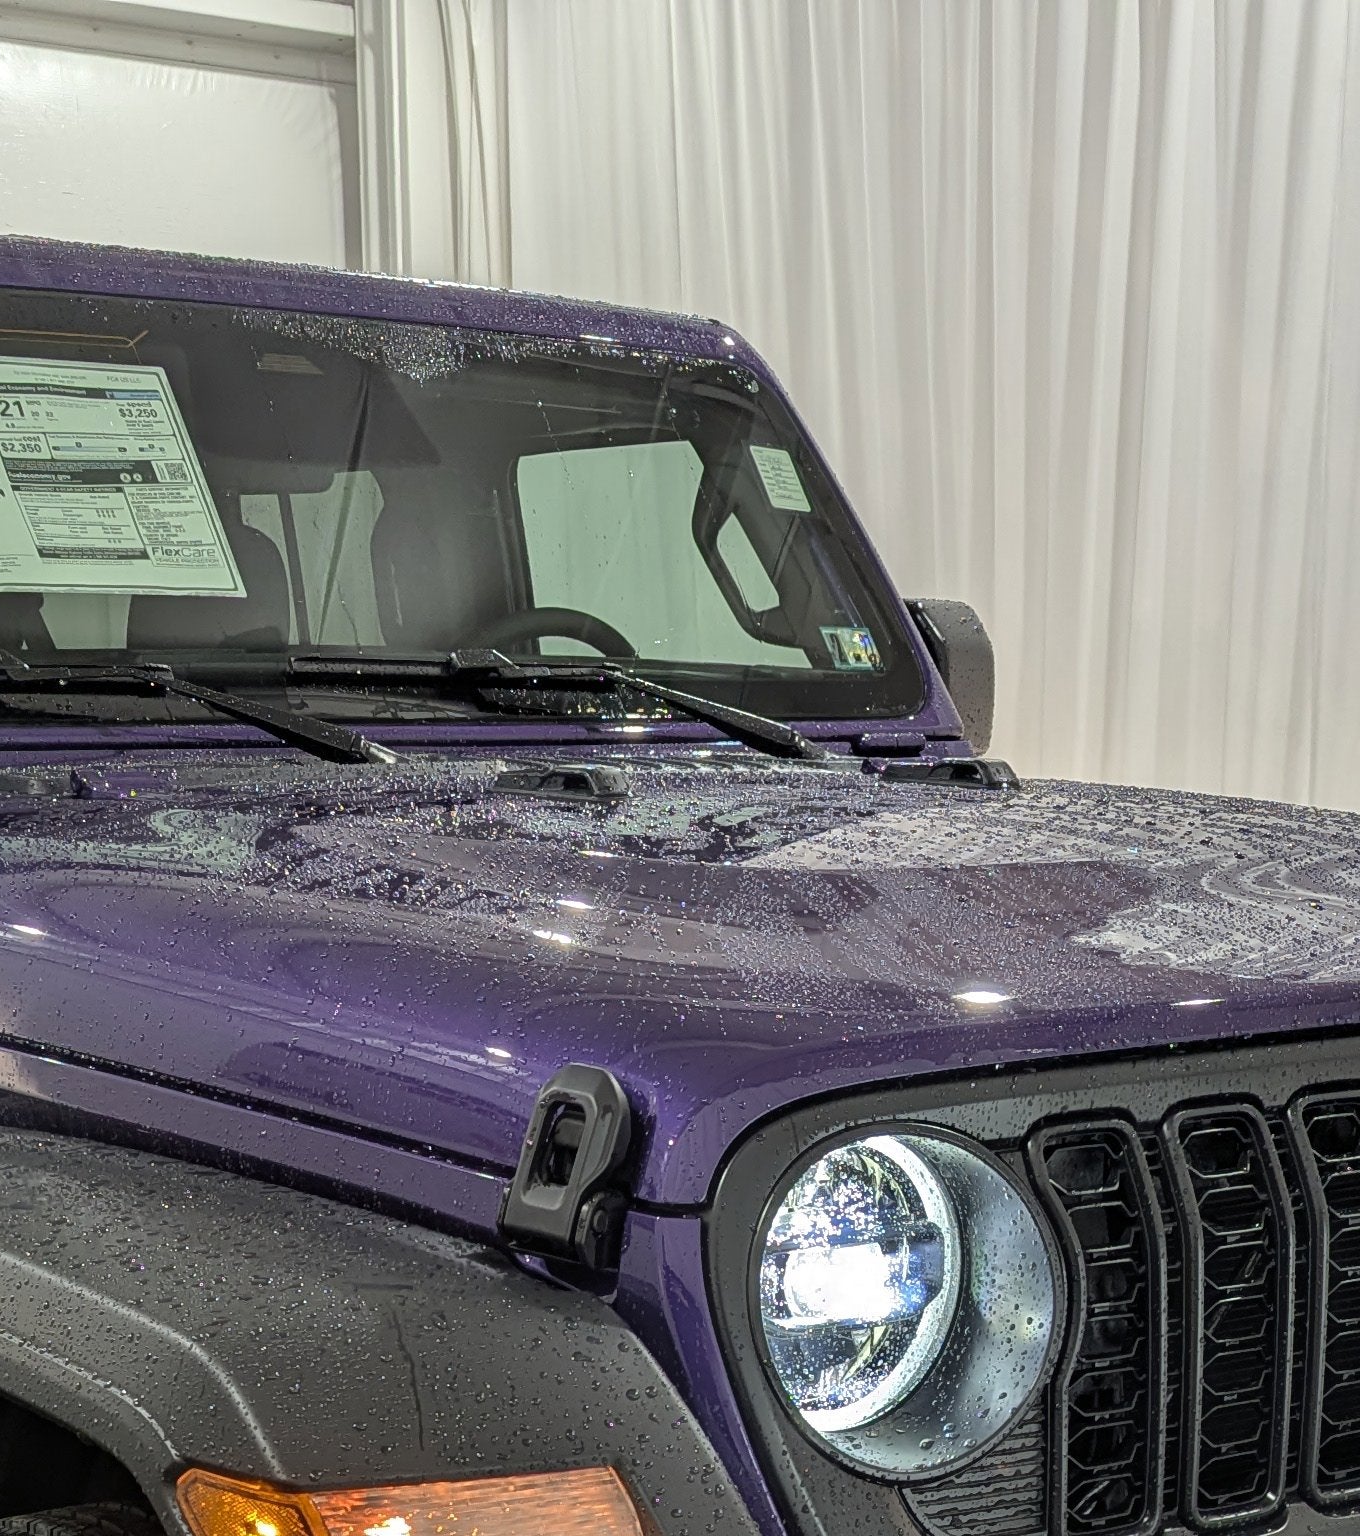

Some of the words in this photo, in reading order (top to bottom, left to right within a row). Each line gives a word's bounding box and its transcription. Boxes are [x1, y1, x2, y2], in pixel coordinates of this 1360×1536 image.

[118, 407, 158, 419] $3,250
[1, 442, 42, 453] $2,350
[151, 546, 216, 558] FlexCare
